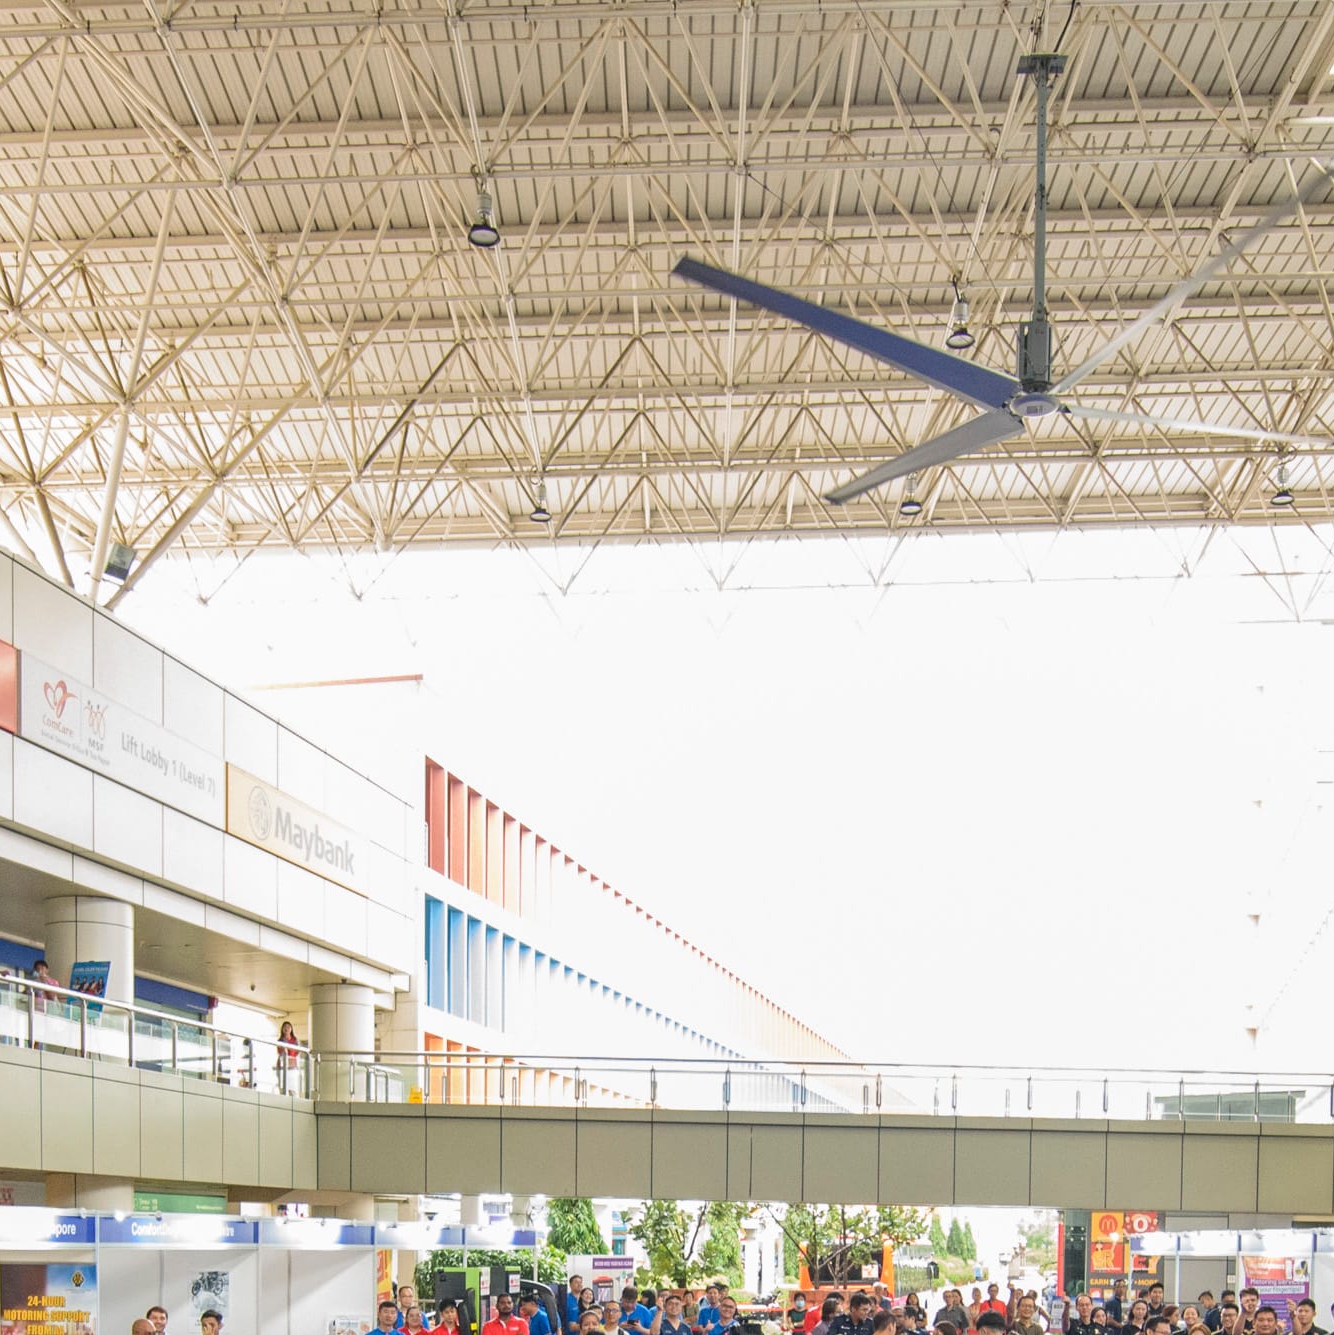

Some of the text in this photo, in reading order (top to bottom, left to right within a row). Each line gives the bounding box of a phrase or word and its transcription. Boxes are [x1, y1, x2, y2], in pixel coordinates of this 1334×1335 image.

[121, 732, 138, 757] Lift
[140, 743, 169, 776] Lobby
[172, 760, 177, 776] 1
[179, 762, 205, 790] (Level
[274, 807, 355, 876] Maybank
[27, 1295, 65, 1307] 24-HOUR
[3, 1309, 91, 1322] MOTORING SUPPORT
[27, 1325, 51, 1335] FROM
